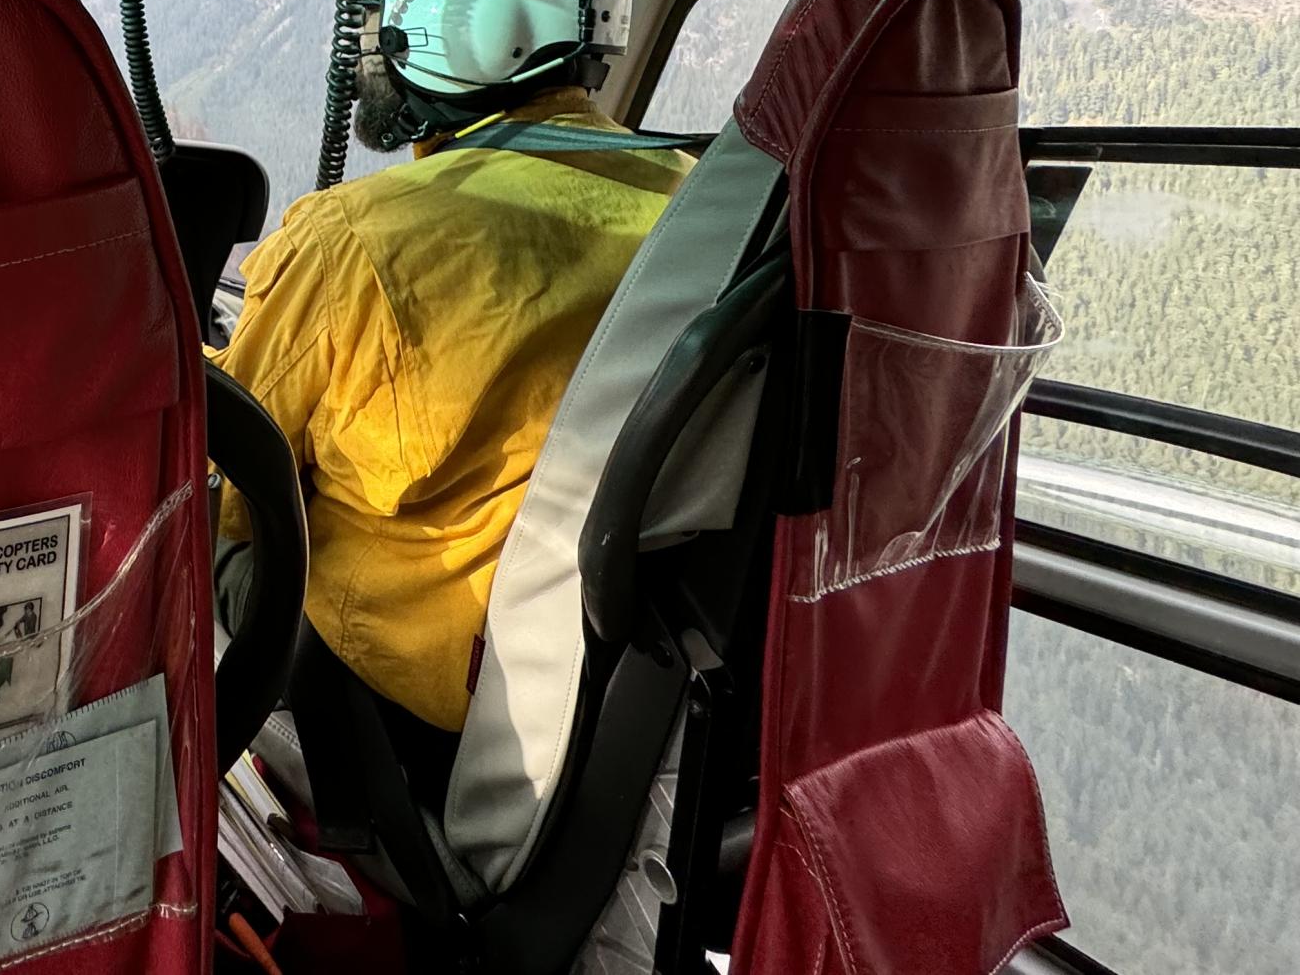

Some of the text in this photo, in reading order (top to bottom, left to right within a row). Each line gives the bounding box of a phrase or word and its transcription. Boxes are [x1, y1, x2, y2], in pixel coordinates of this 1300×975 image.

[16, 551, 57, 571] CARD
[25, 758, 86, 784] DISCOMFORT
[4, 791, 50, 813] ADDITIONAL
[8, 819, 18, 828] AT
[23, 816, 30, 824] A
[34, 802, 73, 819] DISTANCE
